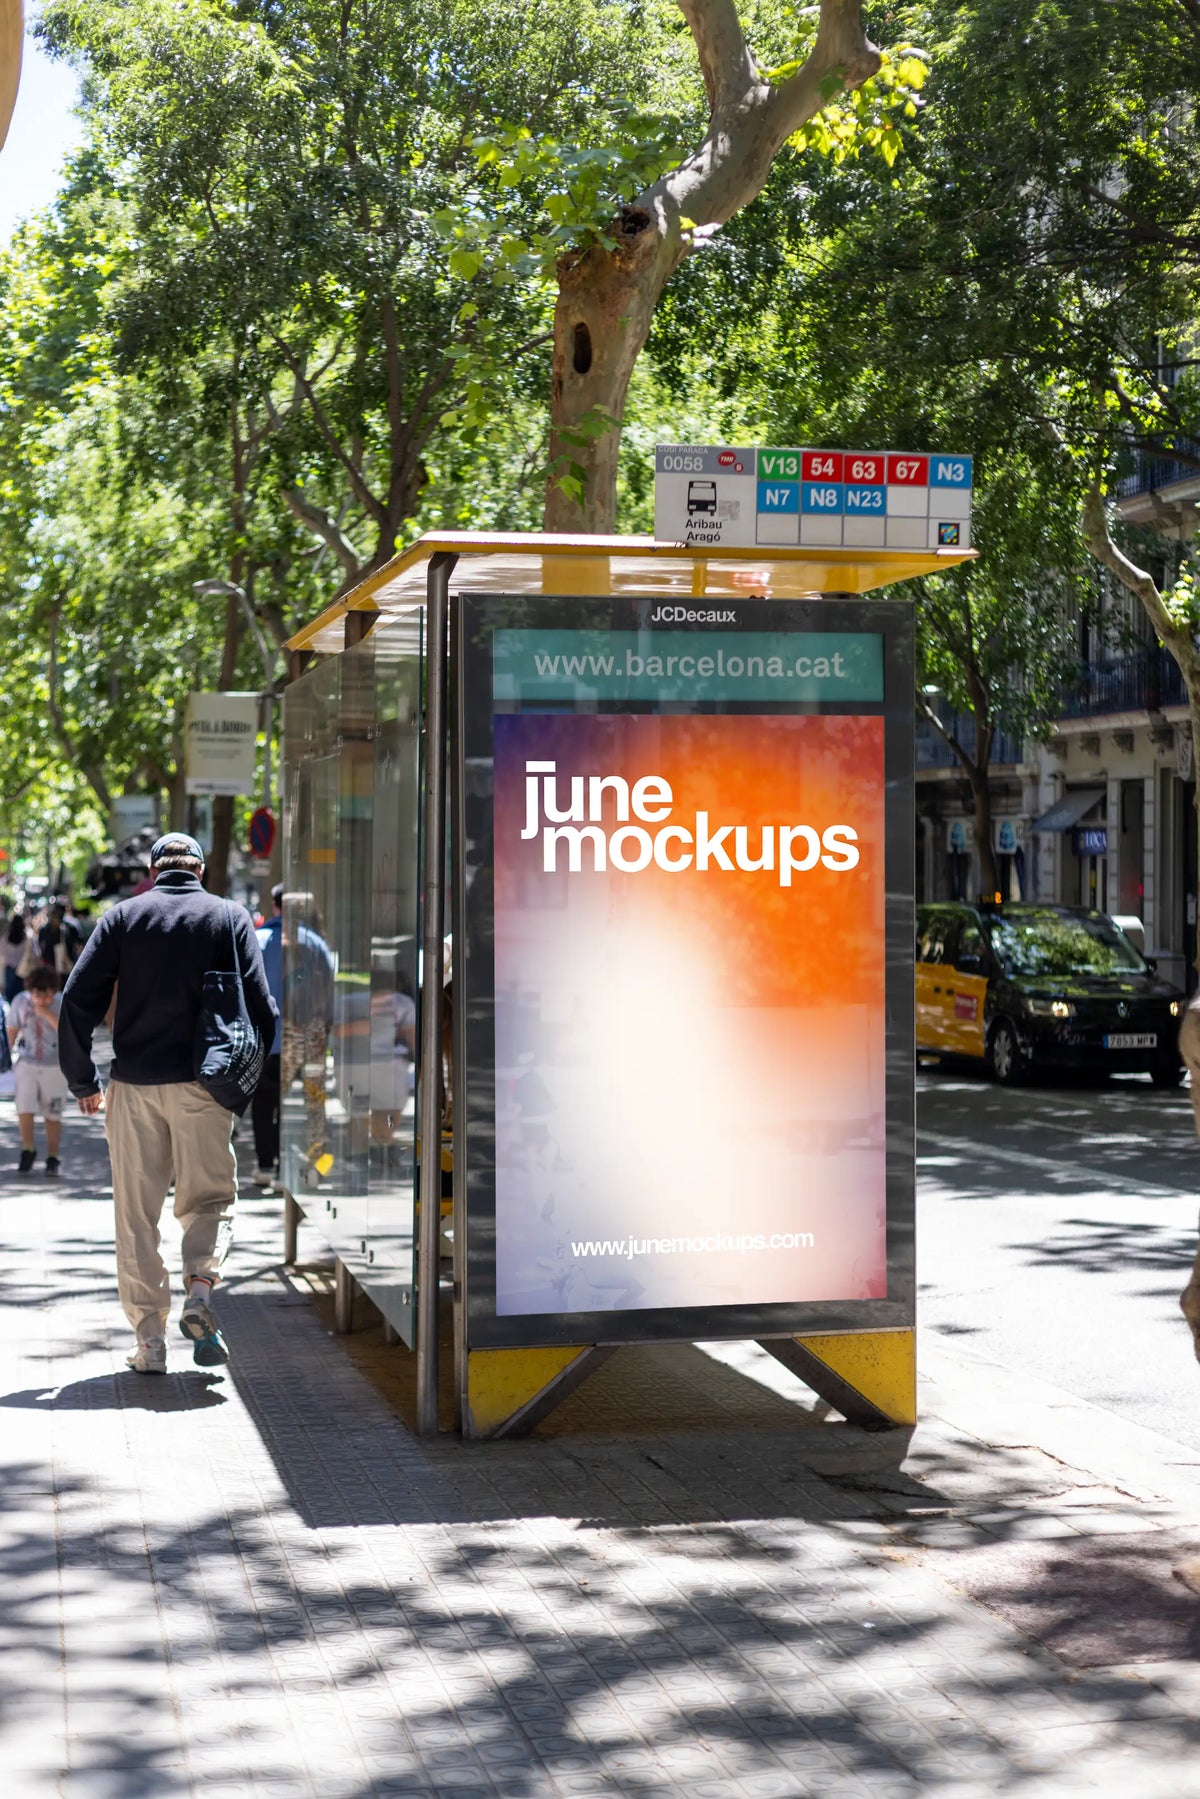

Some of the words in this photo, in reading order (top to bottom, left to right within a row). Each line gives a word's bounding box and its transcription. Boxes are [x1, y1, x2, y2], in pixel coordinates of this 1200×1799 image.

[663, 456, 703, 471] 0058
[762, 456, 798, 475] V13
[810, 457, 834, 476] 54
[852, 460, 876, 480] 63
[895, 460, 920, 480] 67
[937, 462, 965, 482] N3
[766, 489, 791, 506] N7
[810, 488, 837, 507] N8
[847, 490, 883, 508] N23
[685, 519, 722, 529] Aribau
[686, 531, 721, 543] Aragó
[651, 606, 737, 623] JCDecaux
[534, 649, 845, 679] www.barcelona.cat
[521, 761, 673, 840] june
[543, 811, 860, 887] mockups
[571, 1232, 814, 1260] www.junemockups.com
